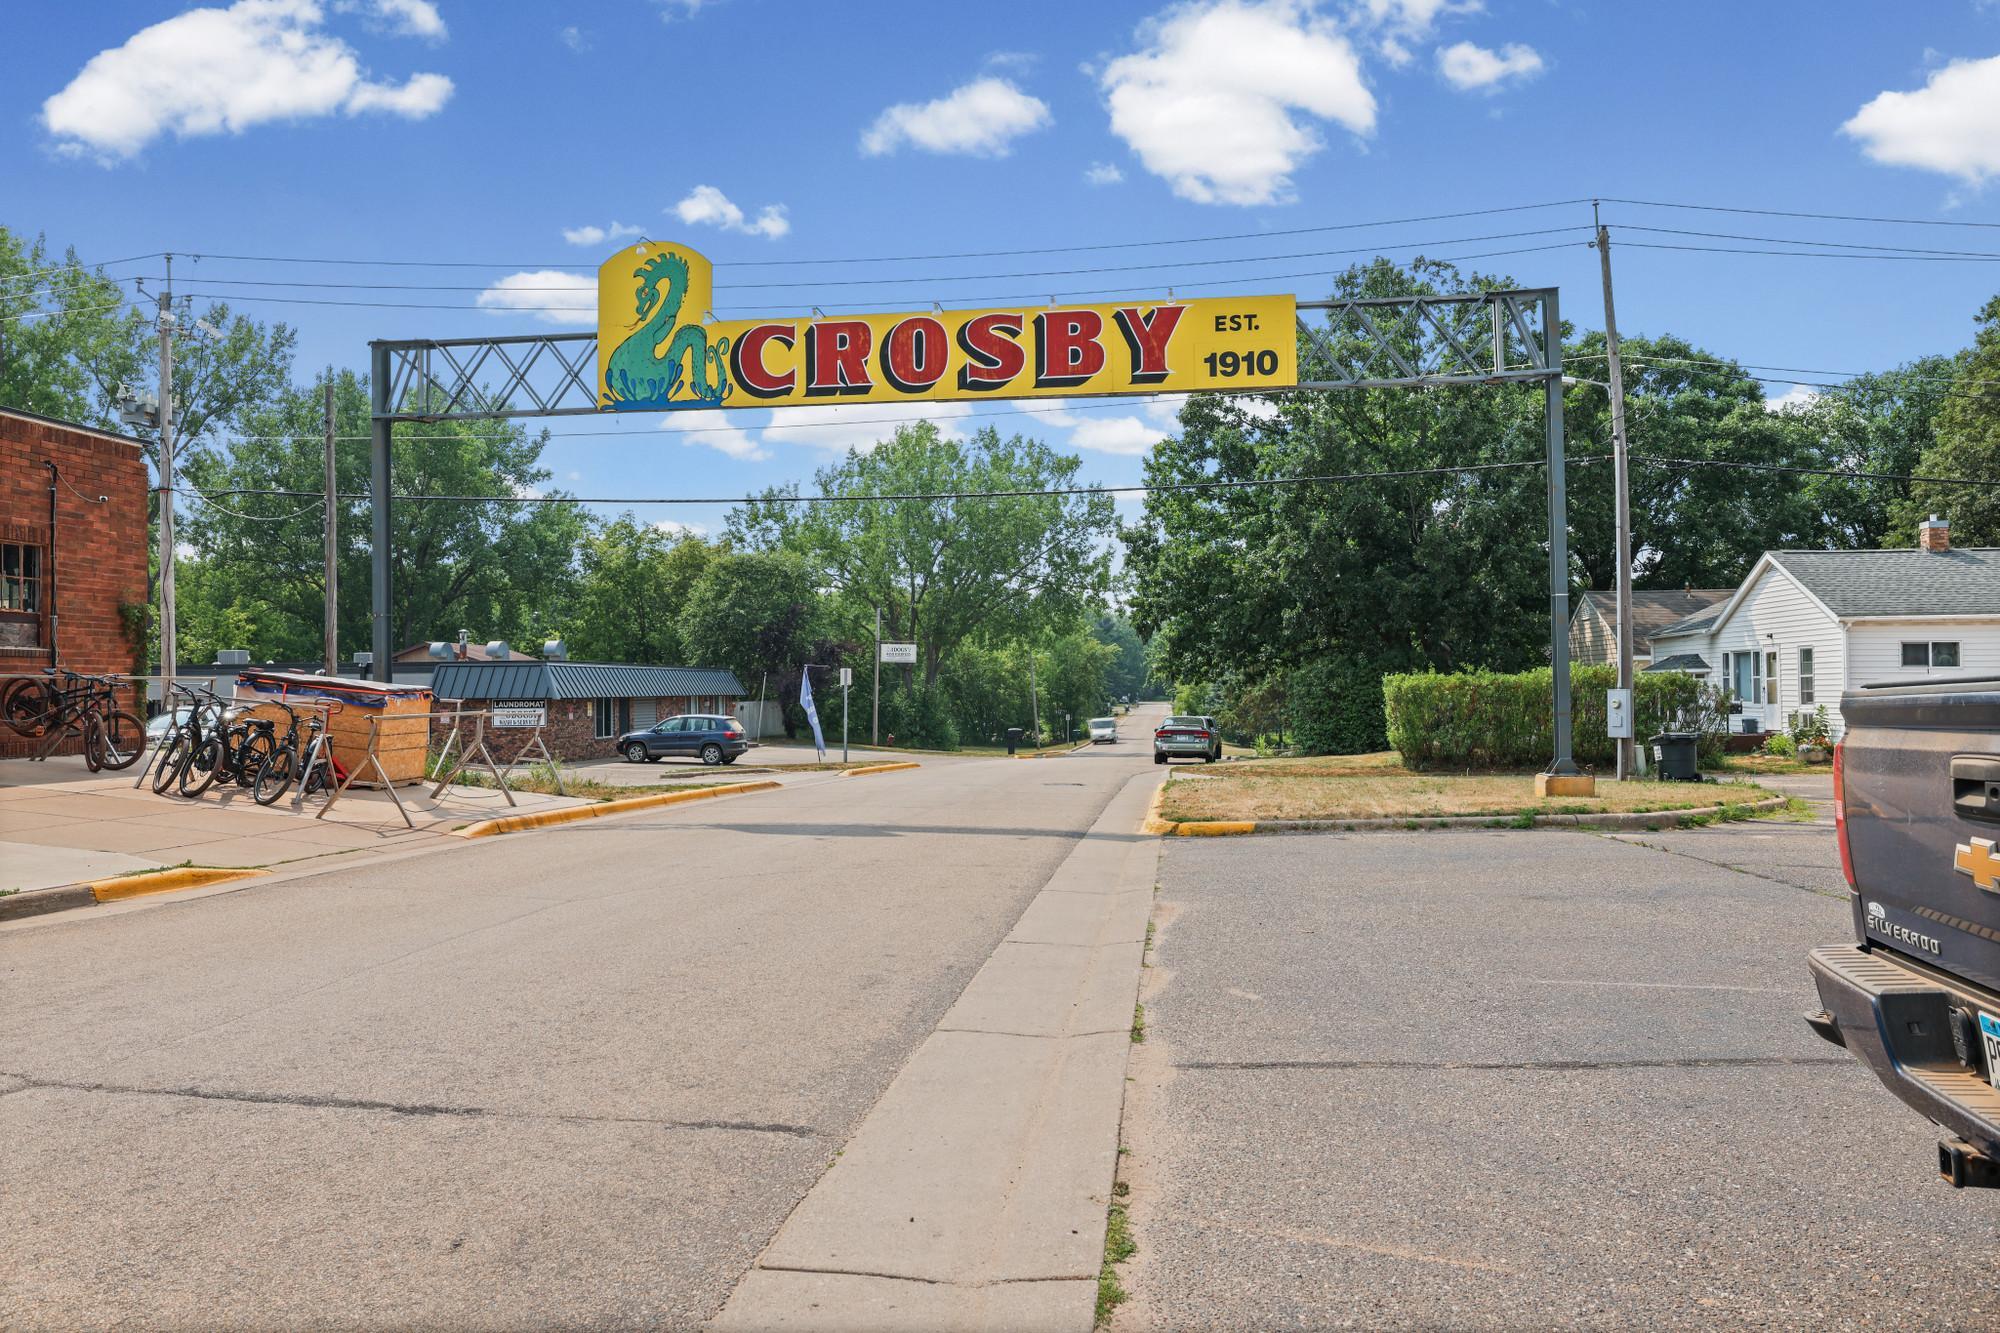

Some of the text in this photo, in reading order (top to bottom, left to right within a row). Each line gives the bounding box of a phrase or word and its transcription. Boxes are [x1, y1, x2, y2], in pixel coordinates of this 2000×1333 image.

[1214, 314, 1260, 332] EST.
[731, 305, 1194, 397] CROSBY
[1203, 350, 1279, 377] 1910
[1867, 914, 1940, 954] SILVERADO
